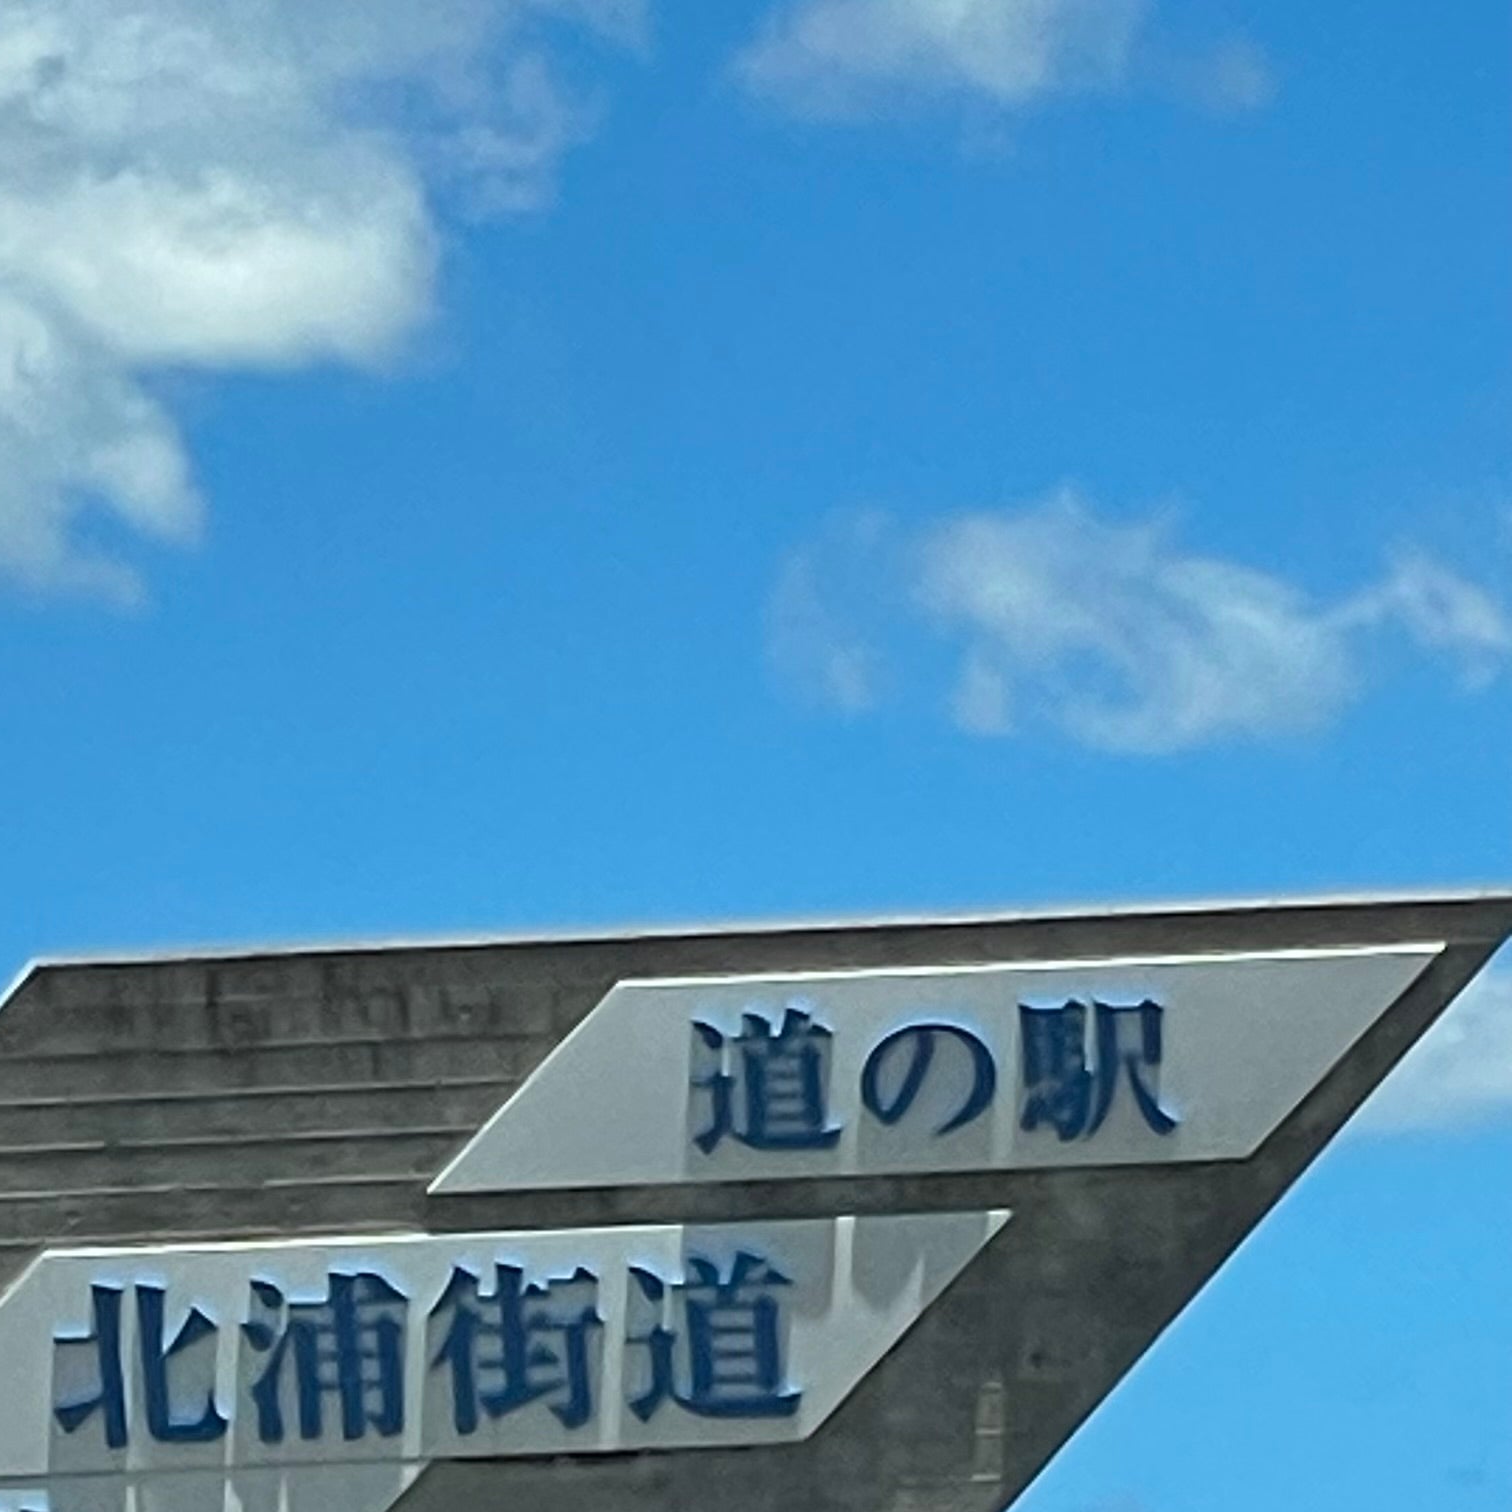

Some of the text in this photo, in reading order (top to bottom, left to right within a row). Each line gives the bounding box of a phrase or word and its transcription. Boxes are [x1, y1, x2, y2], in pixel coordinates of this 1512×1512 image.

[691, 1000, 1179, 1154] 道の駅
[53, 1253, 803, 1447] 北浦街道
